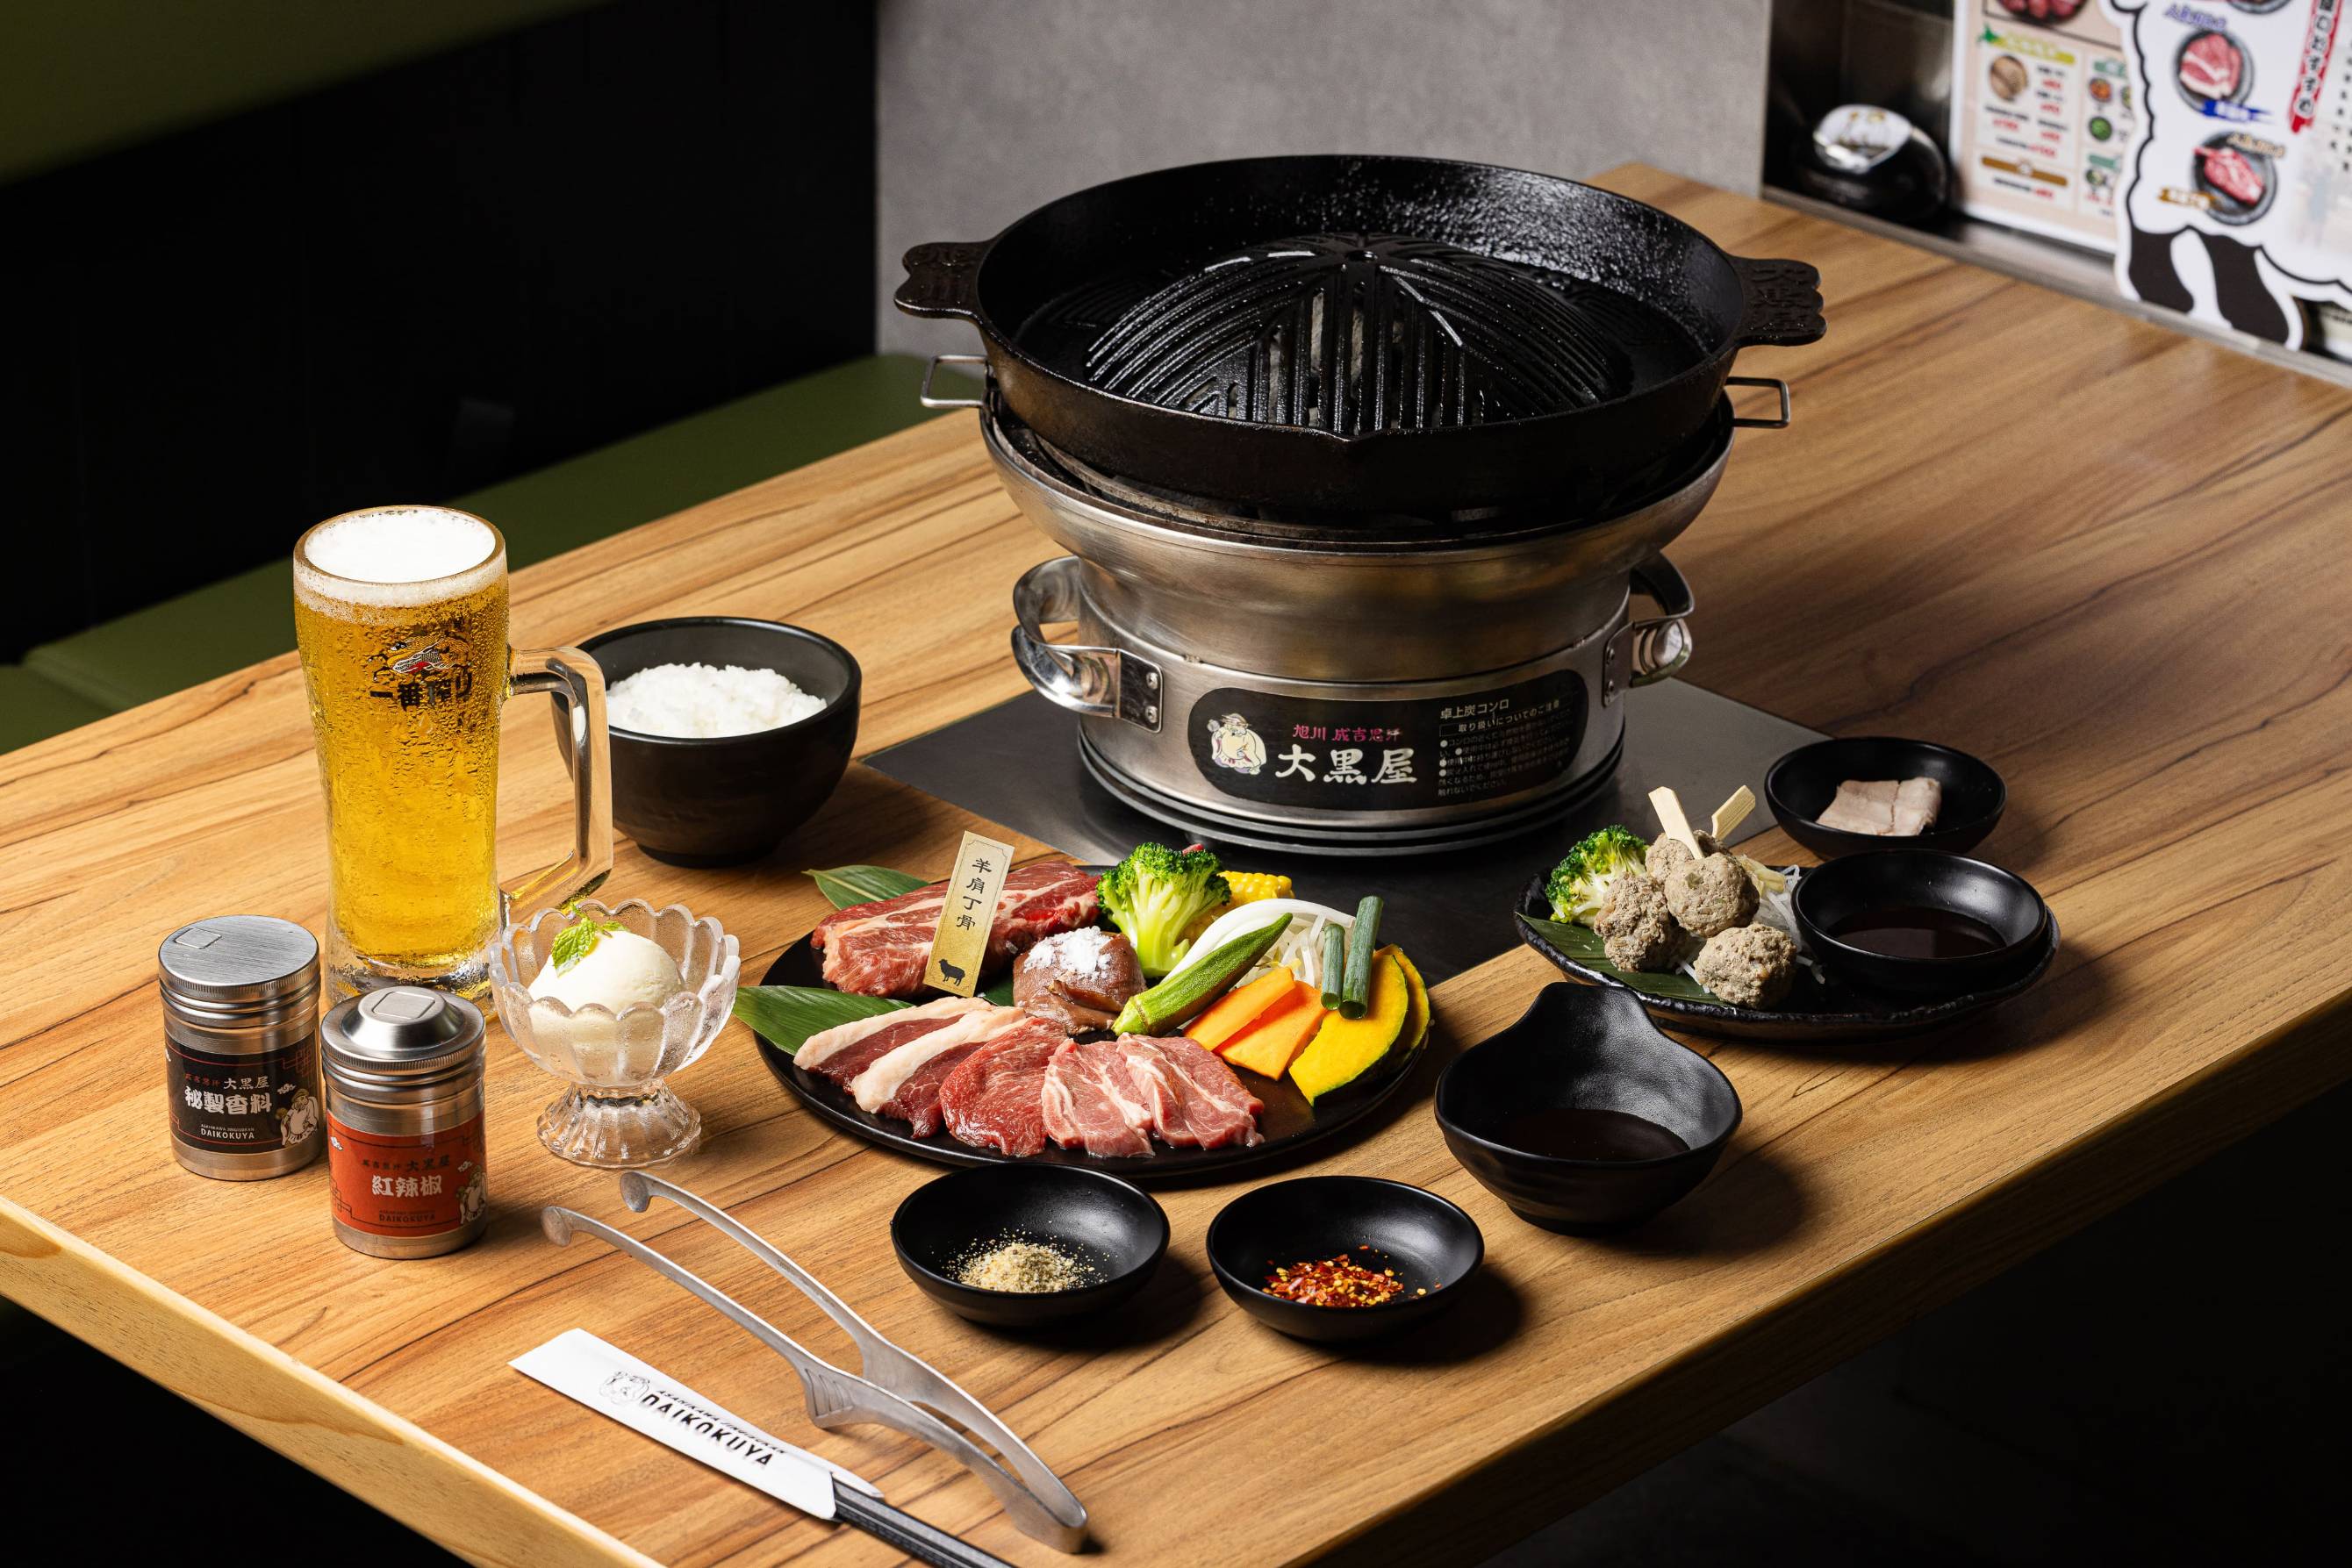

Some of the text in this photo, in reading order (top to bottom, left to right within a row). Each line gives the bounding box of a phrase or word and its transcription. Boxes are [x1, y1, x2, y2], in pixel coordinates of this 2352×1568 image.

[1440, 698, 1509, 720] 卓上炭コンロ
[1292, 724, 1326, 741] 旭川
[1275, 743, 1417, 785] 大黒屋
[956, 857, 992, 931] 羊肩丁骨
[224, 1076, 269, 1090] 大黒屋
[200, 1128, 255, 1139] DAIKOKUYA
[371, 1174, 442, 1198] 紅辣椒
[379, 1214, 435, 1222] DAIKOKUYA
[640, 1393, 774, 1465] DAIKOKUYA
